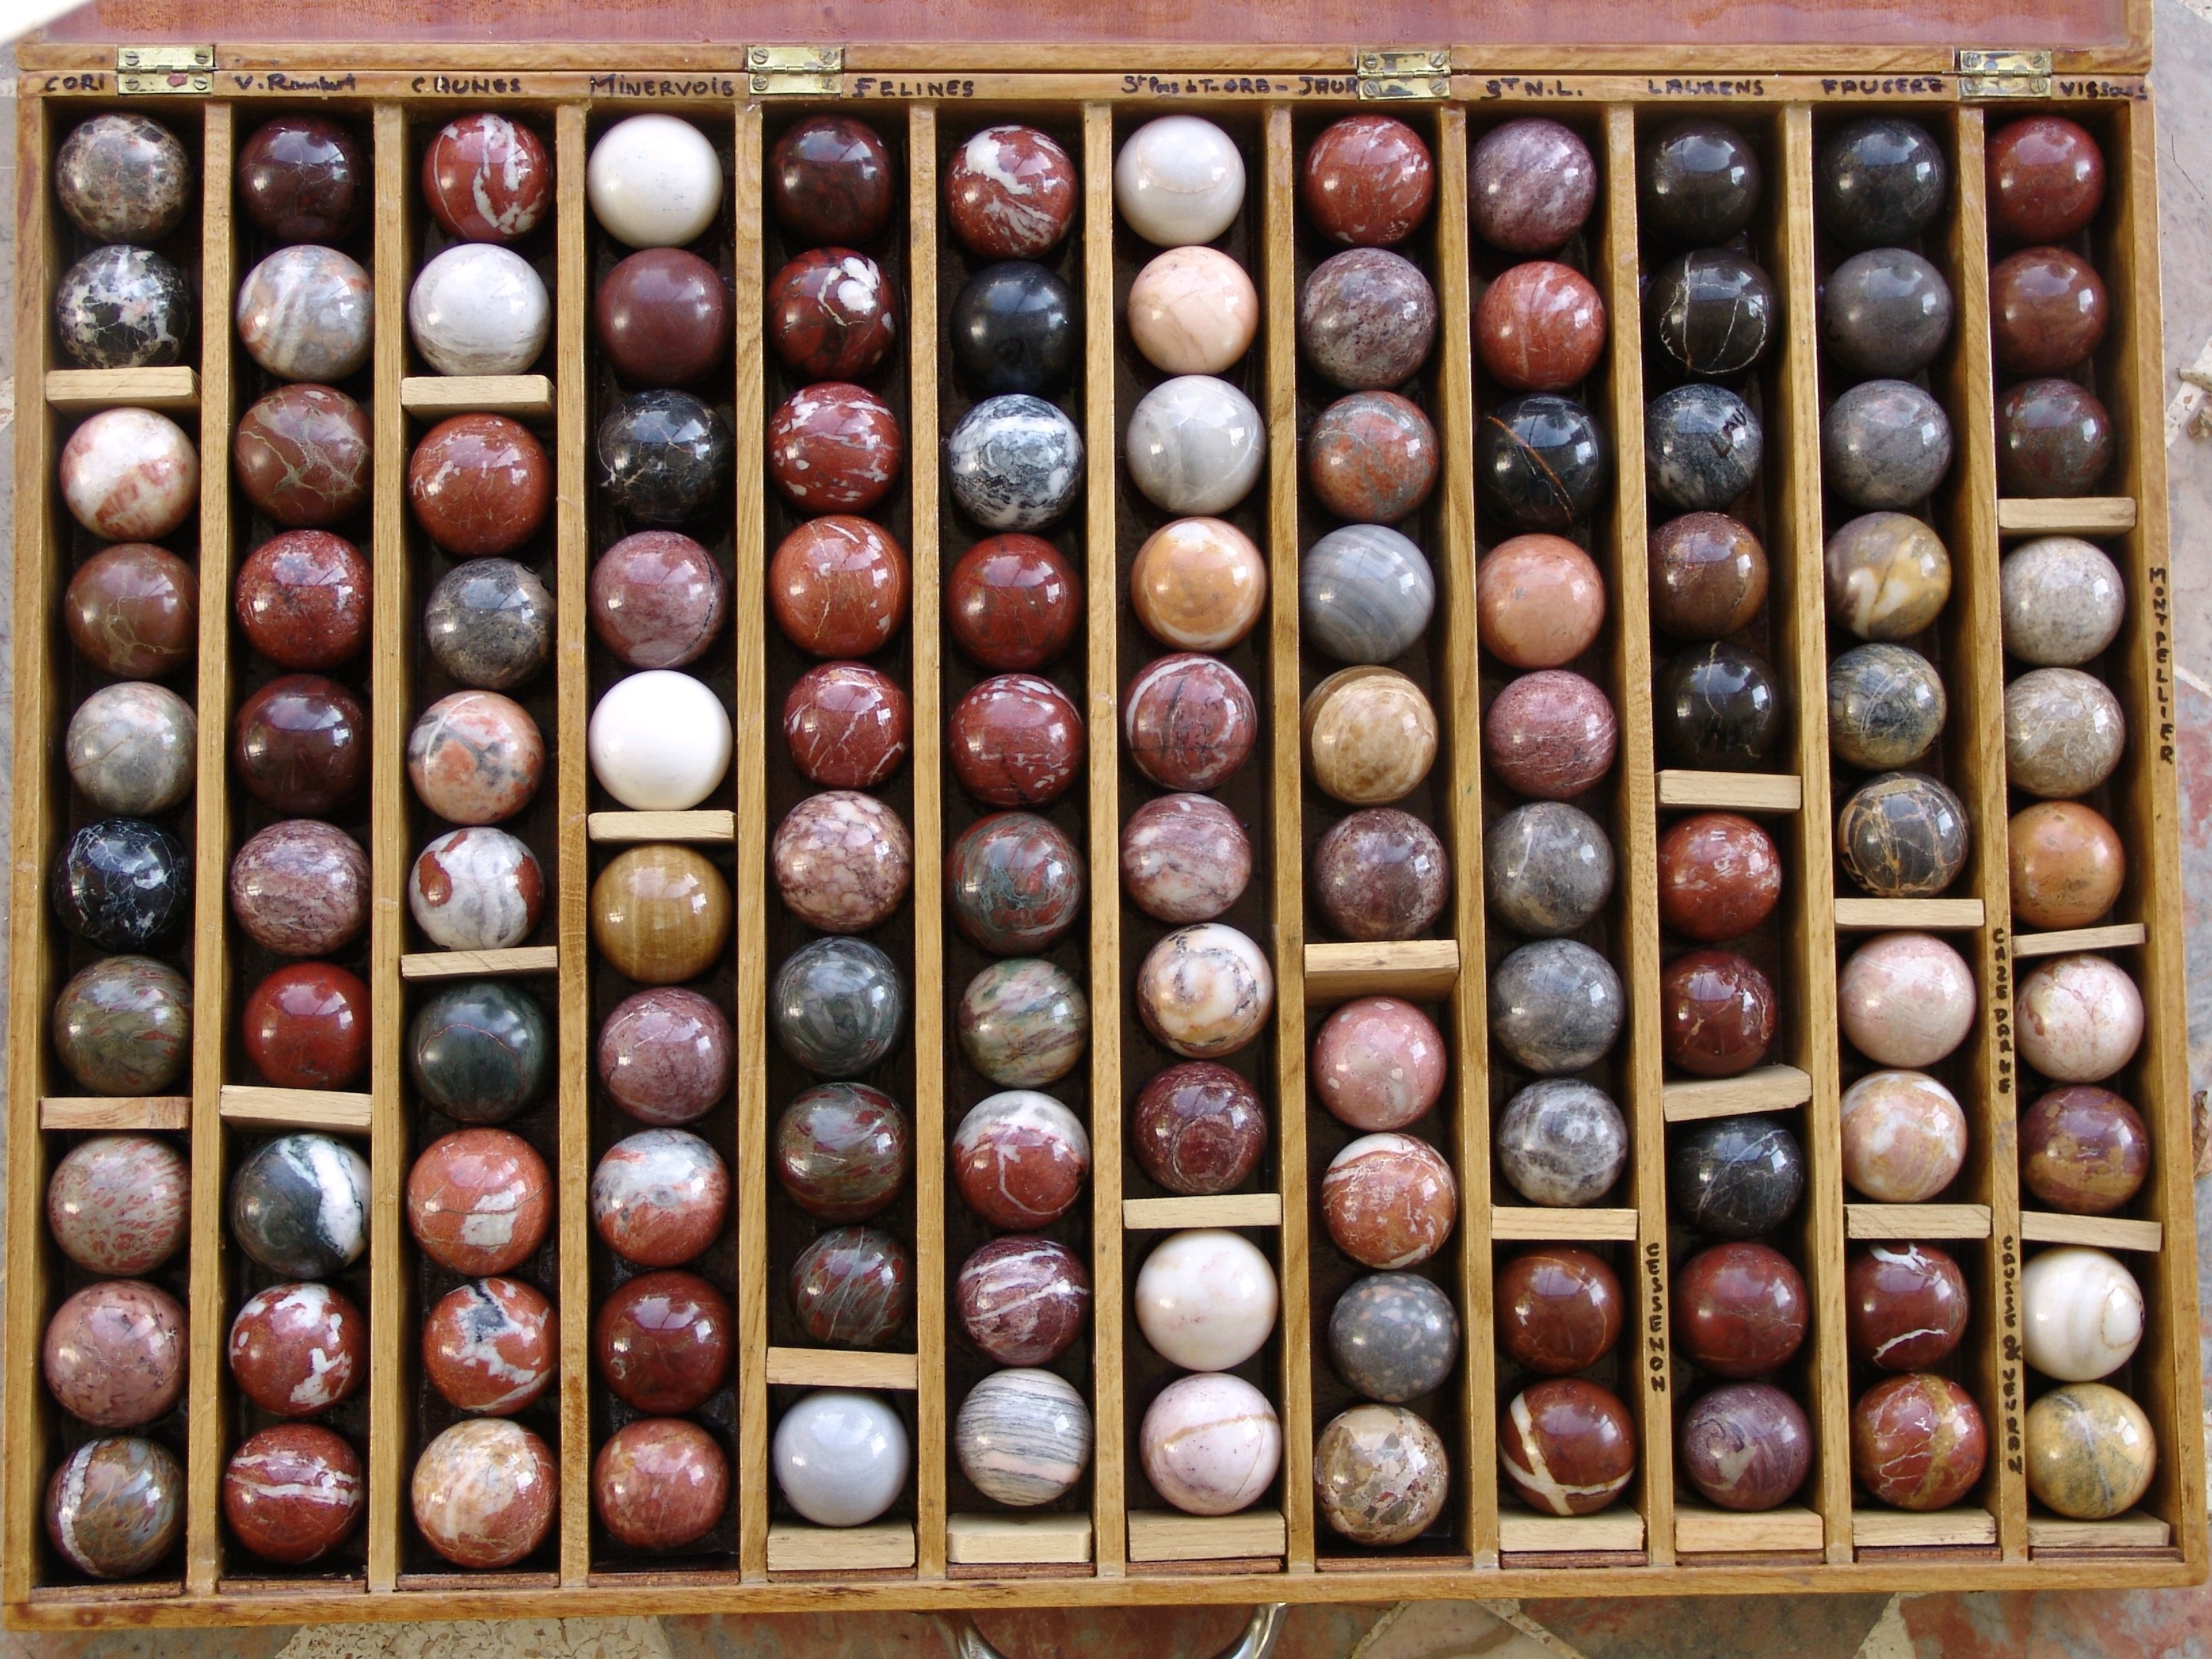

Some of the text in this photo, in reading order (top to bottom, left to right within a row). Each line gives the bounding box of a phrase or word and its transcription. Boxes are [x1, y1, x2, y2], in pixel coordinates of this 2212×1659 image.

[45, 73, 104, 92] CORI
[852, 77, 975, 98] FELINES
[1648, 79, 1763, 96] LAURENS
[2148, 568, 2174, 764] MONTPELLIER
[1645, 1243, 1666, 1392] CESSENON
